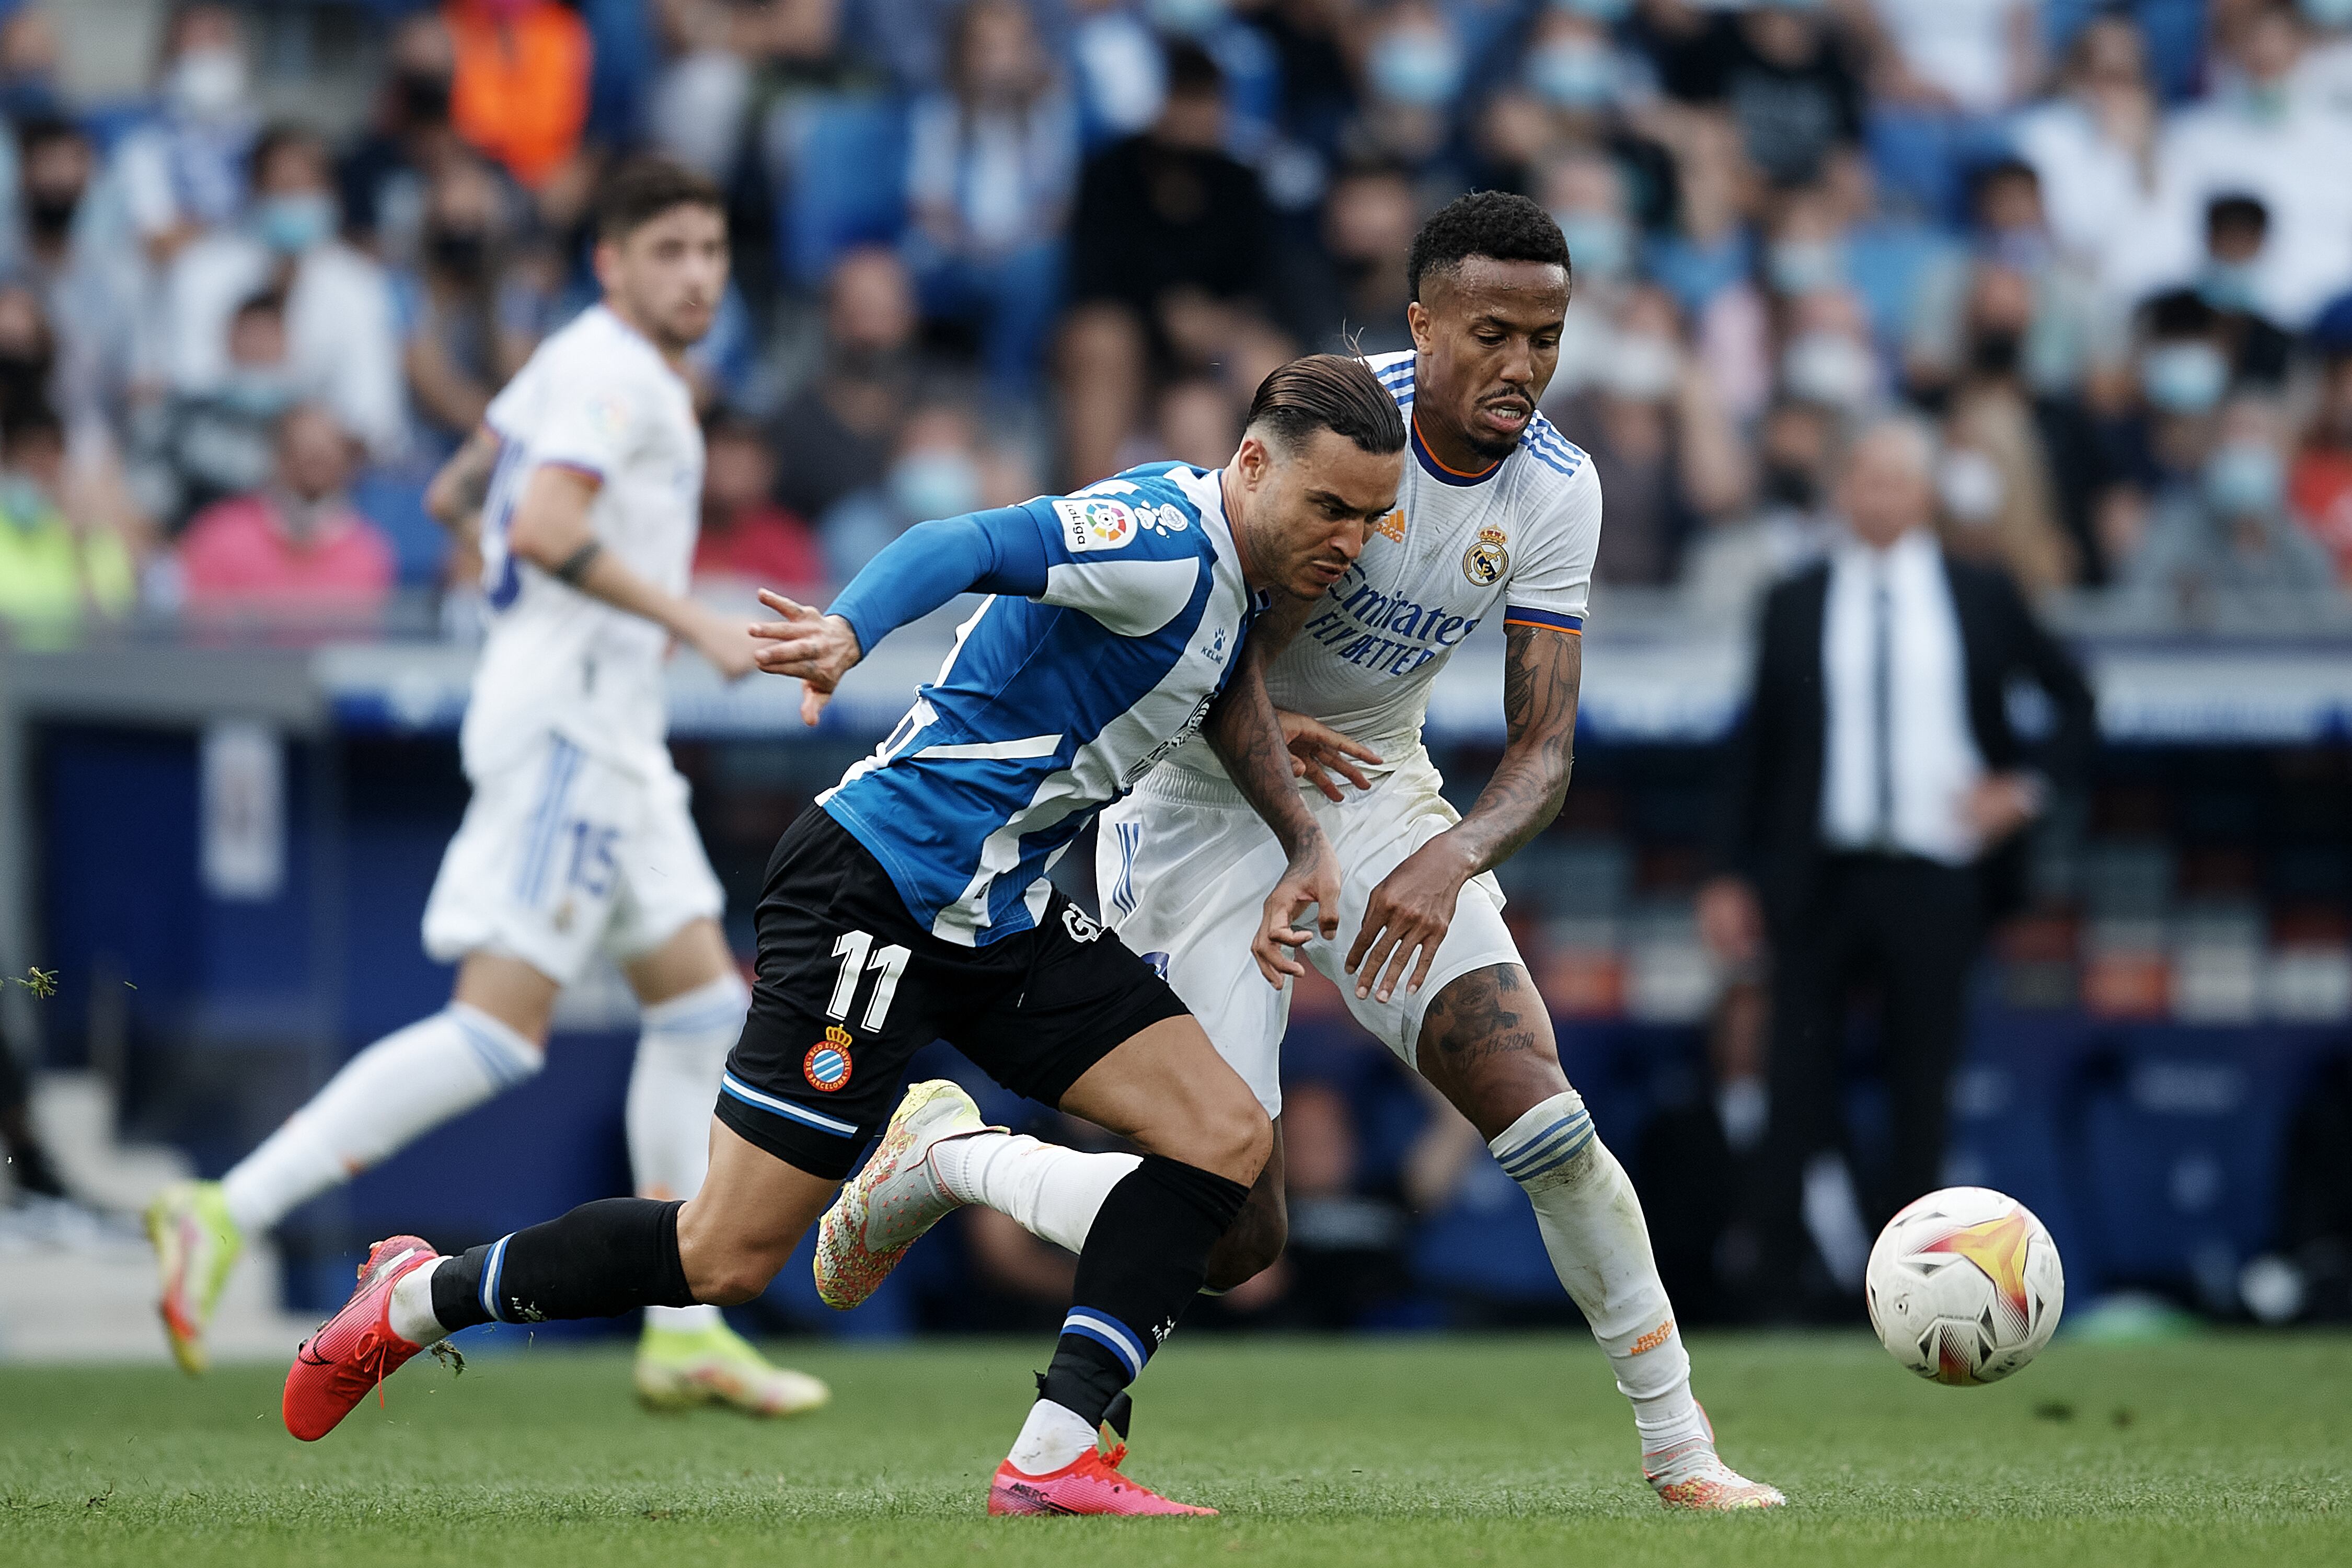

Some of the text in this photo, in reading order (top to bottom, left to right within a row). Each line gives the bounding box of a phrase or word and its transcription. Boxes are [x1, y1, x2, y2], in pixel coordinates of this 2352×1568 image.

[1064, 504, 1086, 545] LaLiga
[1305, 610, 1358, 646] FLY
[826, 930, 912, 1033] 11
[825, 1042, 850, 1071] ESPANYOL
[808, 1073, 847, 1090] BARCELONA
